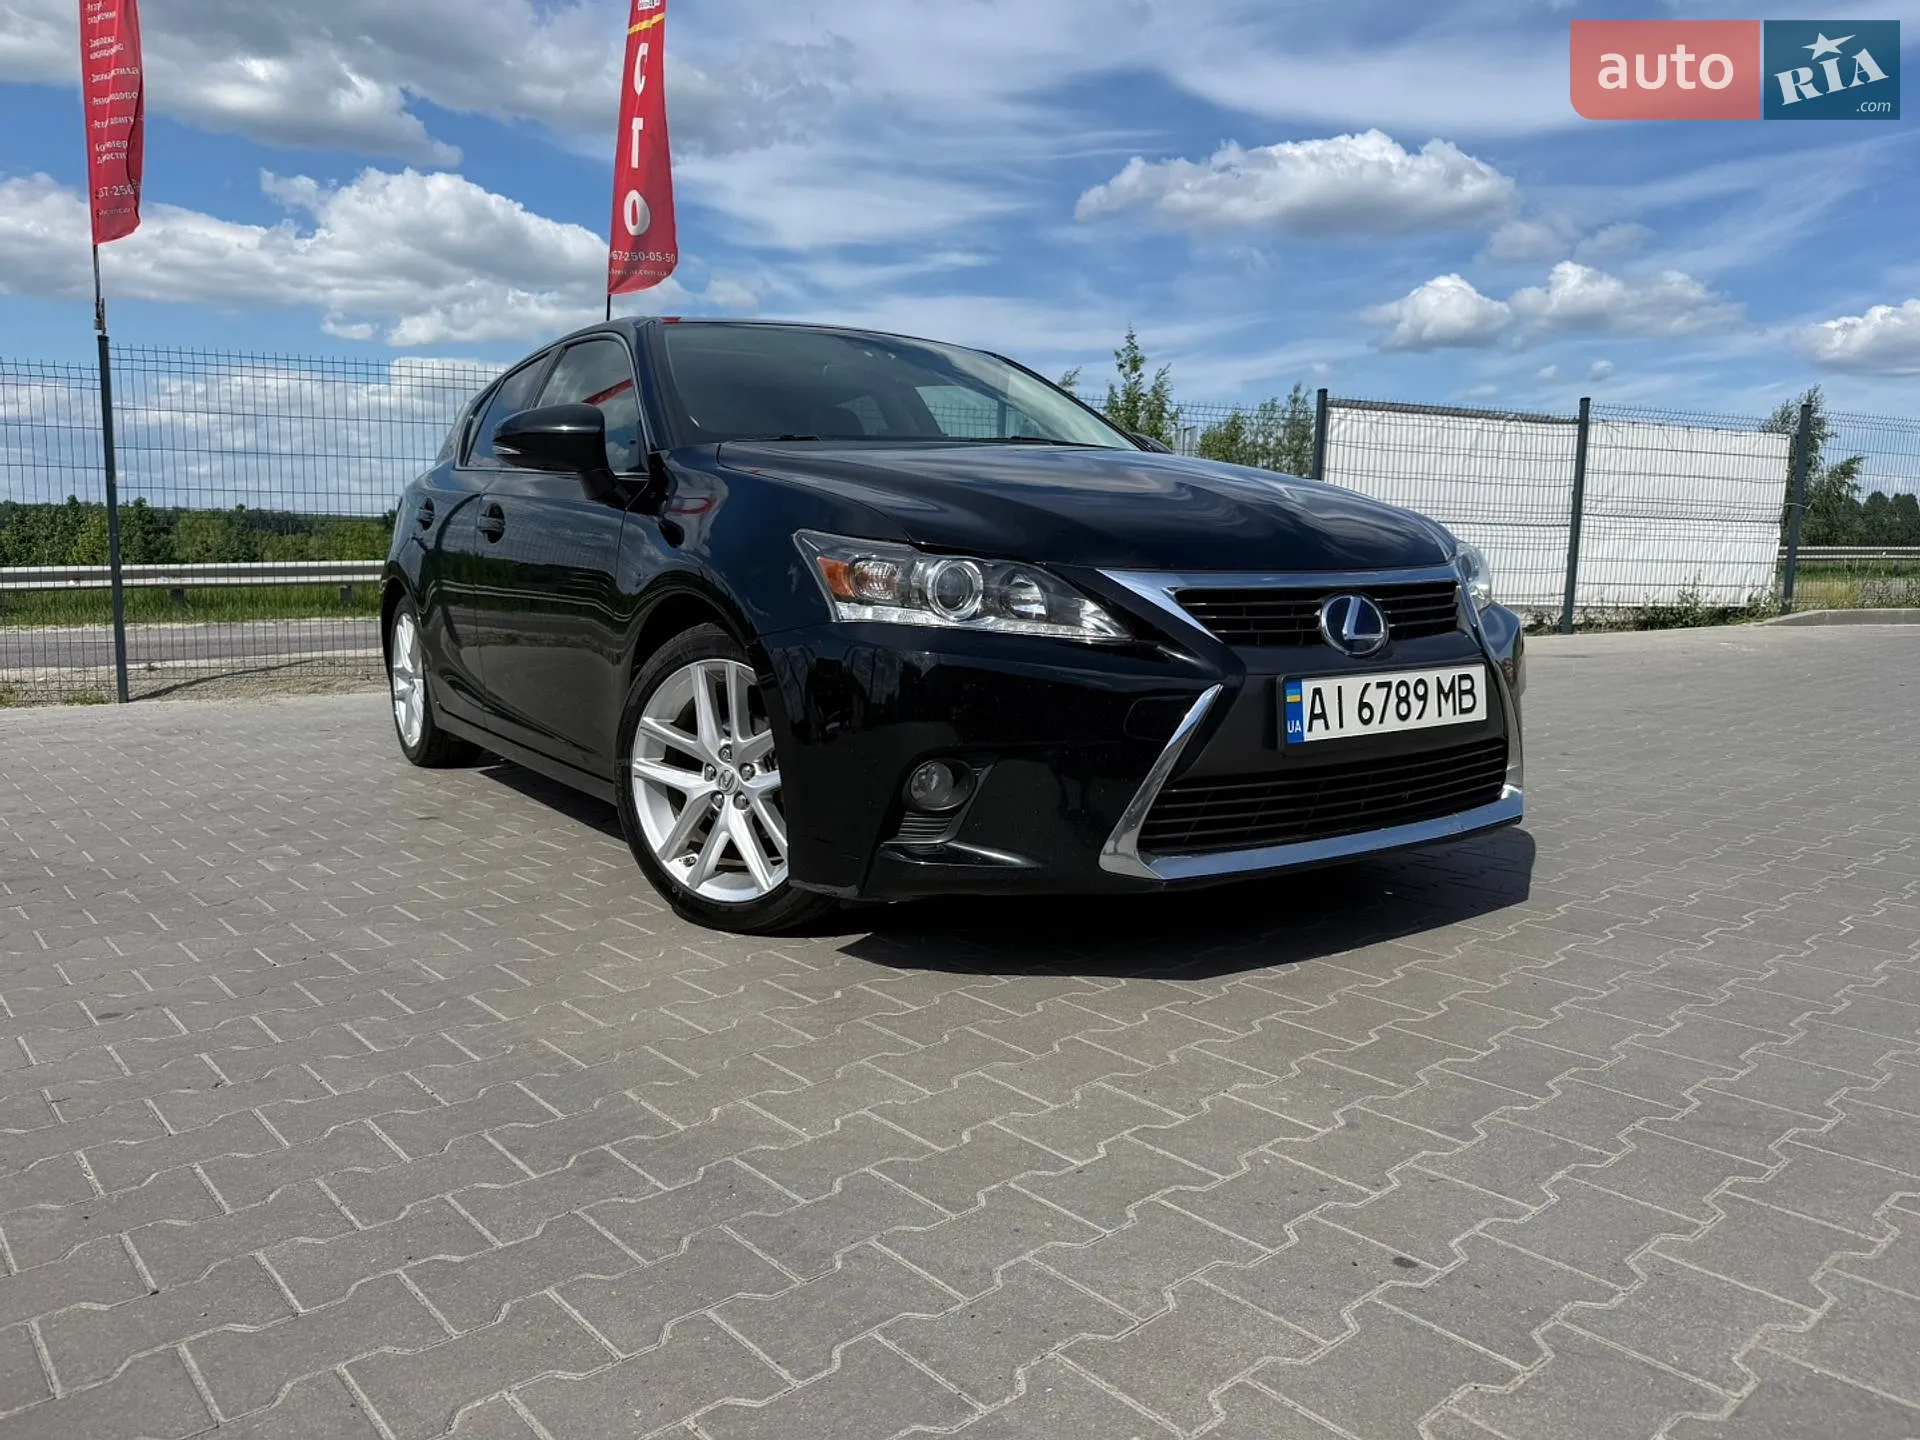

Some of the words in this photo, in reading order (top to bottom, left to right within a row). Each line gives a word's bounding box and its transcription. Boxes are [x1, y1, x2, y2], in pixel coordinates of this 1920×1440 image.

[1307, 685, 1344, 732] AI
[1357, 677, 1429, 726] 6789
[1436, 673, 1477, 718] MB
[1287, 719, 1302, 734] UA
